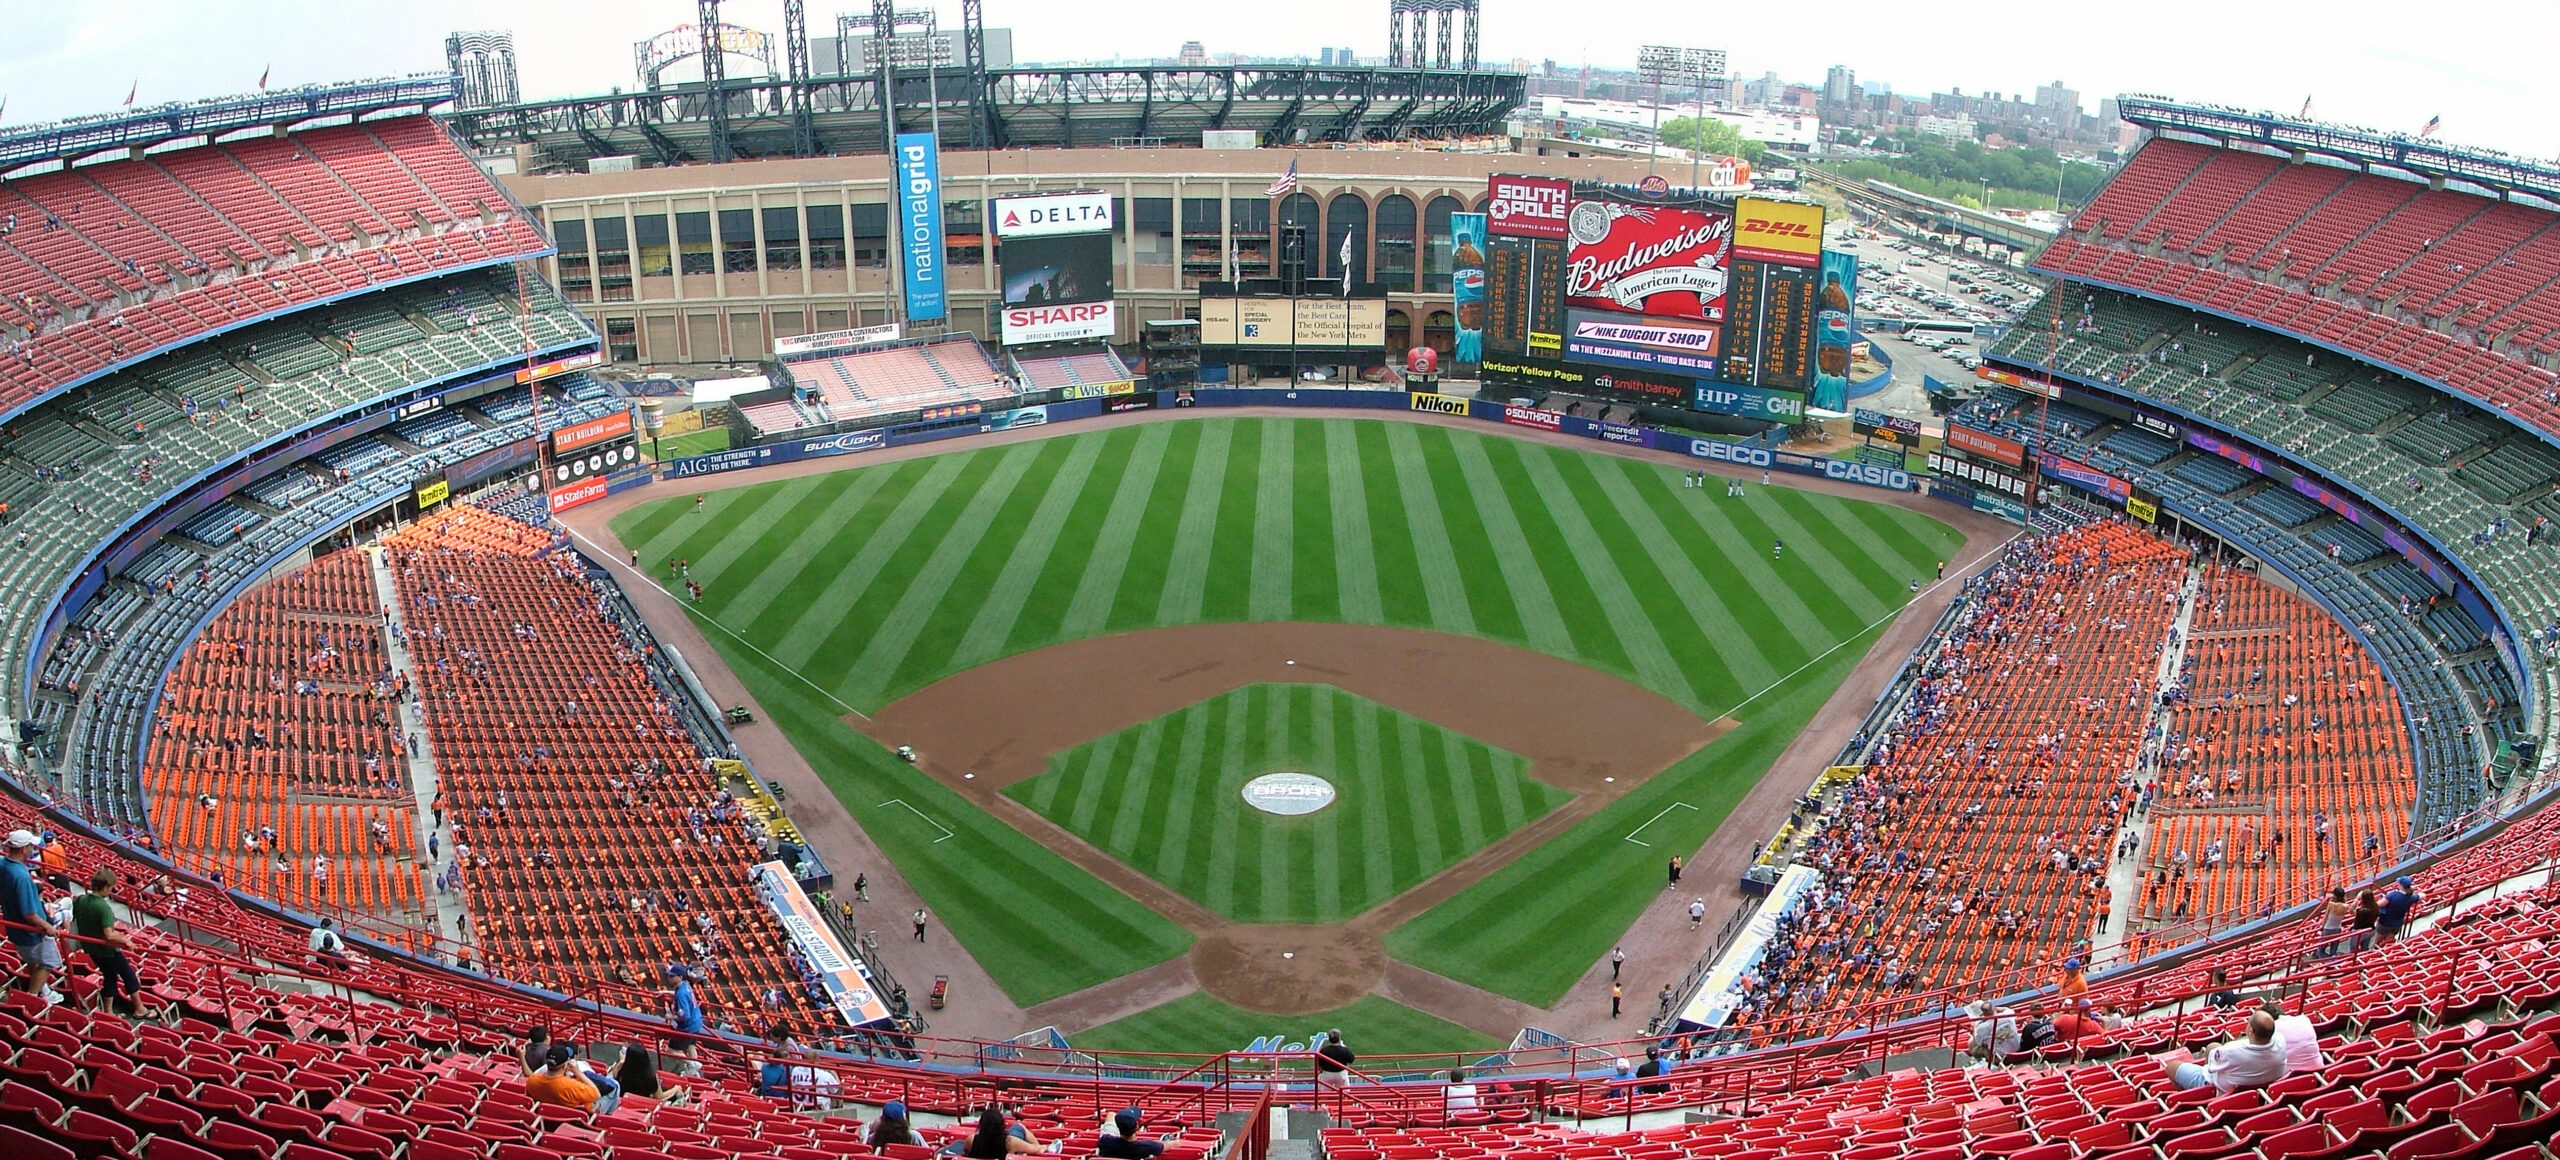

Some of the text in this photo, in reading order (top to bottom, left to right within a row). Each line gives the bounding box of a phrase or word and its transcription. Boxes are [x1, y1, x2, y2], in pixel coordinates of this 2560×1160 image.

[1710, 161, 1736, 187] citi
[1498, 184, 1566, 204] SOUTH
[1641, 178, 1669, 193] Mets
[903, 145, 932, 281] nationalgrid
[1030, 205, 1106, 224] DELTA
[1511, 200, 1565, 219] POLE
[1743, 219, 1811, 239] DHL
[1566, 216, 1733, 297] Budweiser
[1623, 274, 1719, 299] American Lager
[1009, 305, 1108, 327] SHARP
[854, 326, 893, 337] CONTRACTORS
[1054, 330, 1081, 338] SPONSOR
[1343, 322, 1373, 331] Hospital
[1375, 322, 1383, 330] of
[1595, 326, 1707, 346] NIKE DUGOUT SHOP
[1570, 344, 1713, 369] ON THE MEZZANINE LEVEL THIRD BASE SIDE
[1521, 366, 1551, 378] Yellow
[1554, 370, 1583, 382] Pages
[1079, 385, 1105, 397] WISE
[1595, 375, 1682, 398] citi smith barney
[1416, 395, 1465, 414] Nikon
[1698, 389, 1738, 405] HIP
[1767, 397, 1802, 417] GHI
[1856, 409, 1882, 423] AZEK
[1512, 409, 1560, 425] SOUTHPOLE
[1890, 418, 1916, 431] AZEK
[556, 432, 577, 446] START
[577, 424, 604, 440] BUILDING
[1588, 423, 1598, 431] 371
[1604, 423, 1639, 436] freecredit
[1875, 428, 1894, 439] AZEK
[805, 434, 882, 452] BUD LIGHT
[1604, 431, 1643, 444] report.com
[1951, 431, 1997, 453] START BUILDING
[711, 450, 756, 463] THE STRENGTH
[1691, 440, 1770, 466] GEICO
[678, 459, 708, 475] AIG
[730, 459, 751, 468] THERE.
[1827, 460, 1910, 490] CASIO
[421, 486, 446, 503] Armitron
[1976, 493, 2025, 515] amtrak.com
[2129, 500, 2154, 517] Armitron
[790, 917, 844, 969] SHEA STADIUM
